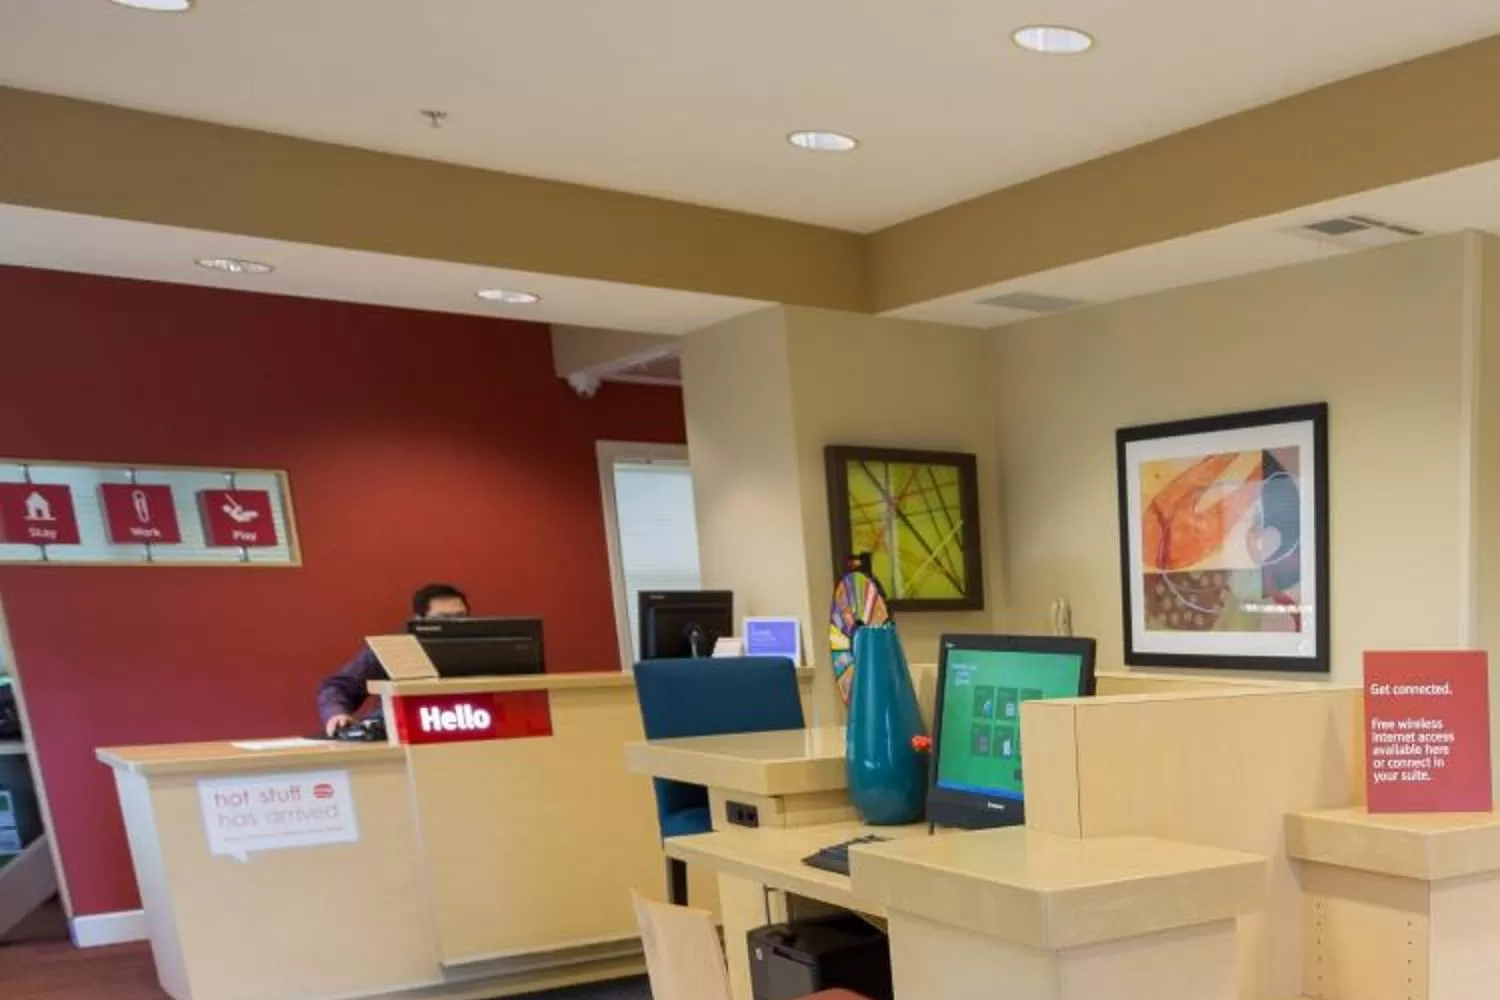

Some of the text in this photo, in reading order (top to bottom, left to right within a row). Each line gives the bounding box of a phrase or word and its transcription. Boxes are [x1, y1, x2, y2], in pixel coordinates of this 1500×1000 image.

[28, 526, 58, 540] Stay
[130, 526, 161, 538] Work
[232, 530, 258, 542] Play
[1370, 682, 1453, 696] Get connected.
[419, 703, 493, 732] Hello
[1371, 717, 1444, 730] Free wireless
[1417, 732, 1456, 743] access
[1373, 743, 1450, 755] available here
[1373, 756, 1445, 769] or connect in
[1373, 769, 1432, 784] your suite.
[213, 783, 301, 808] hot stuff
[217, 804, 339, 829] has arrived
